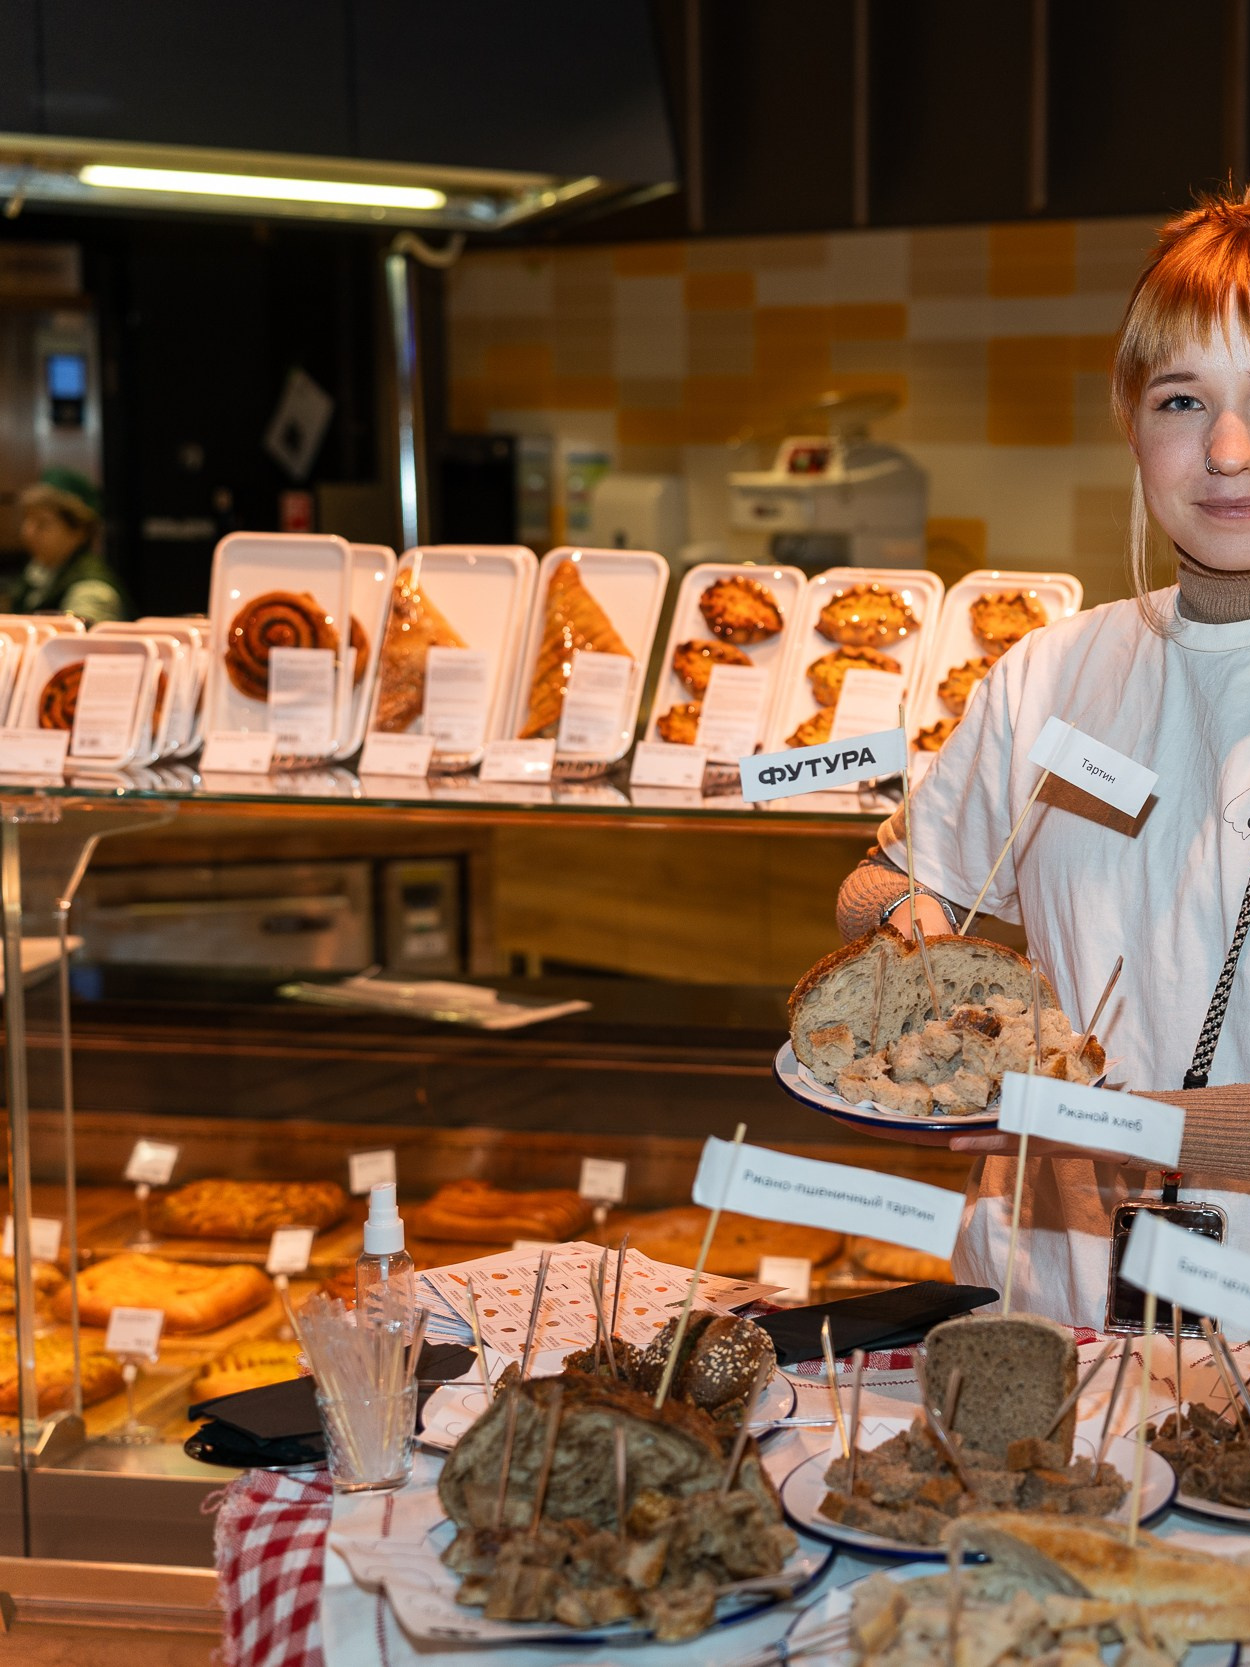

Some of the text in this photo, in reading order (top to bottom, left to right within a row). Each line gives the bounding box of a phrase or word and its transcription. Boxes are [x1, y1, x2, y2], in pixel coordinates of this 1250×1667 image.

[758, 746, 877, 786] ФУТУРА
[1081, 757, 1117, 784] Тартин
[1057, 1103, 1144, 1133] Ржаной хлеб
[885, 1200, 936, 1223] тартин
